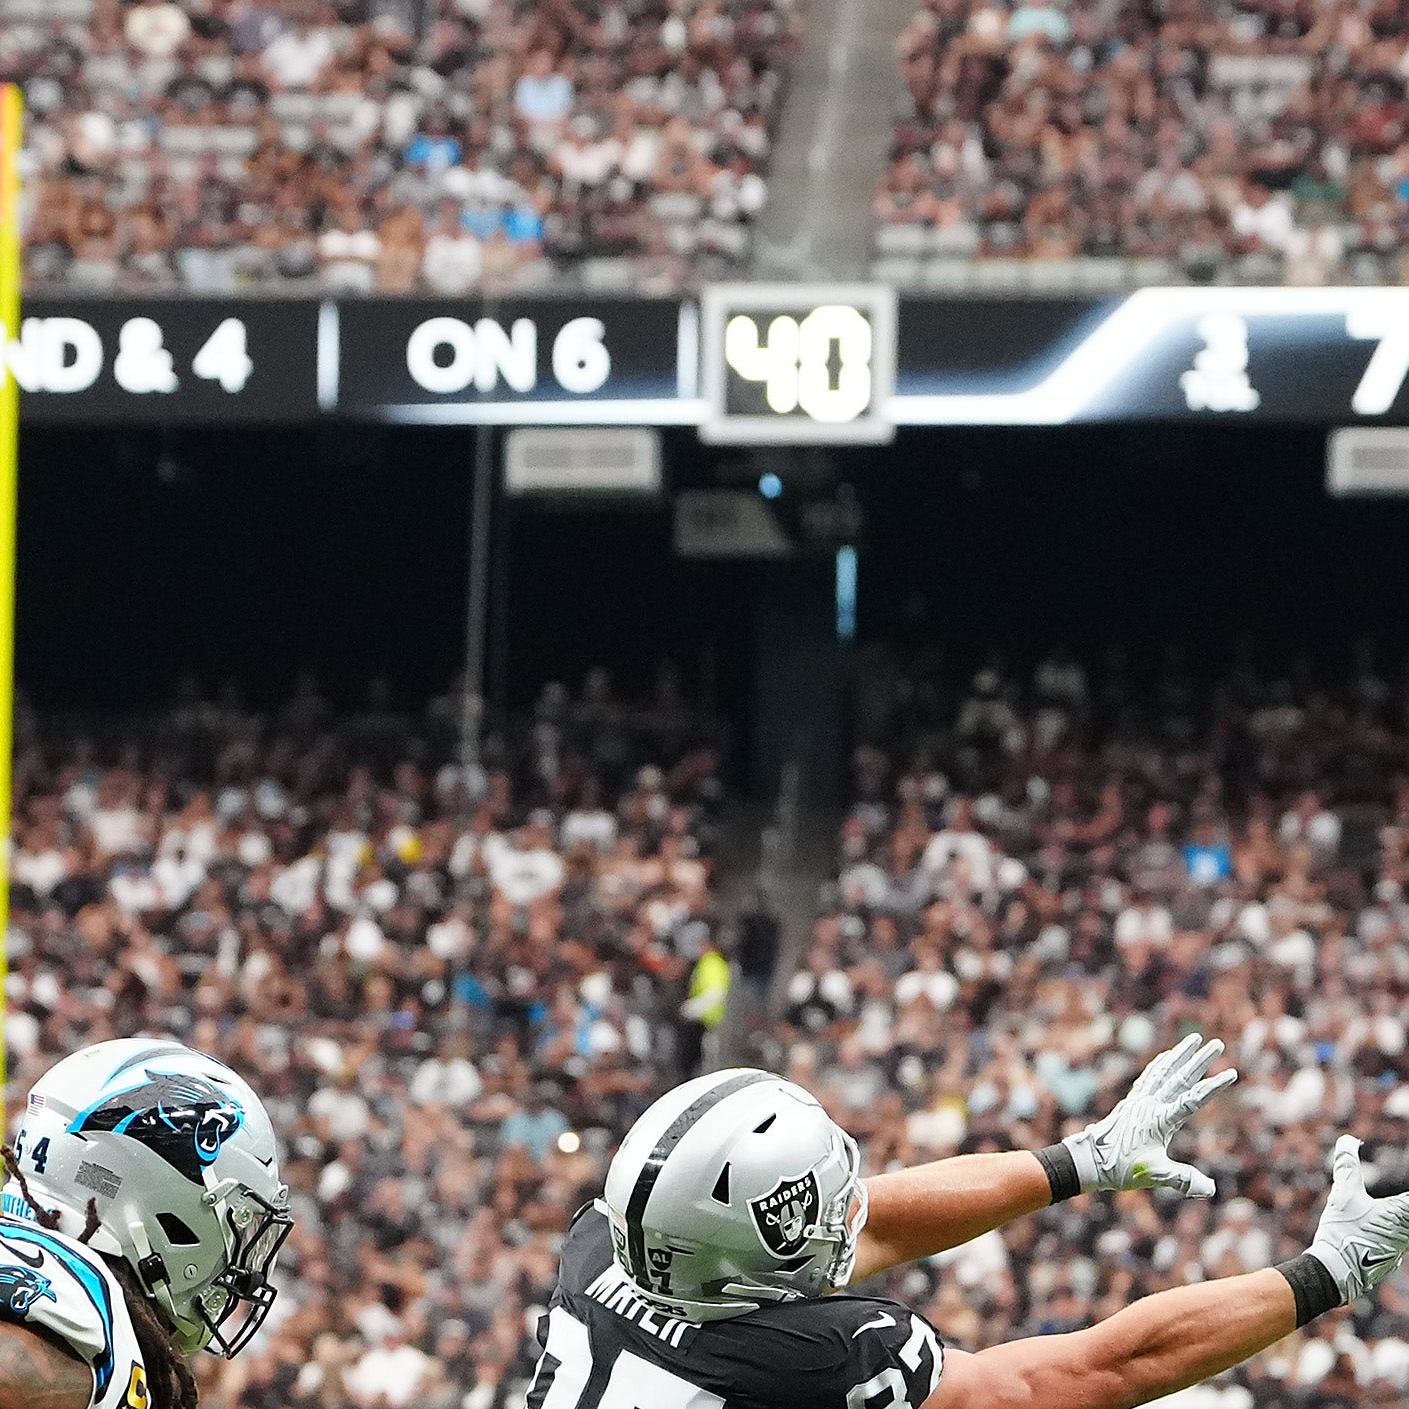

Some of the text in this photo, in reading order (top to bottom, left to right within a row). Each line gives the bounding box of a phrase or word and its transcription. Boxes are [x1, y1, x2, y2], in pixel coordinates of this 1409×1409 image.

[114, 317, 179, 394] &
[192, 318, 253, 394] 4
[406, 317, 611, 393] ON 6
[759, 1177, 812, 1212] RAIDERS
[651, 1251, 671, 1264] AL
